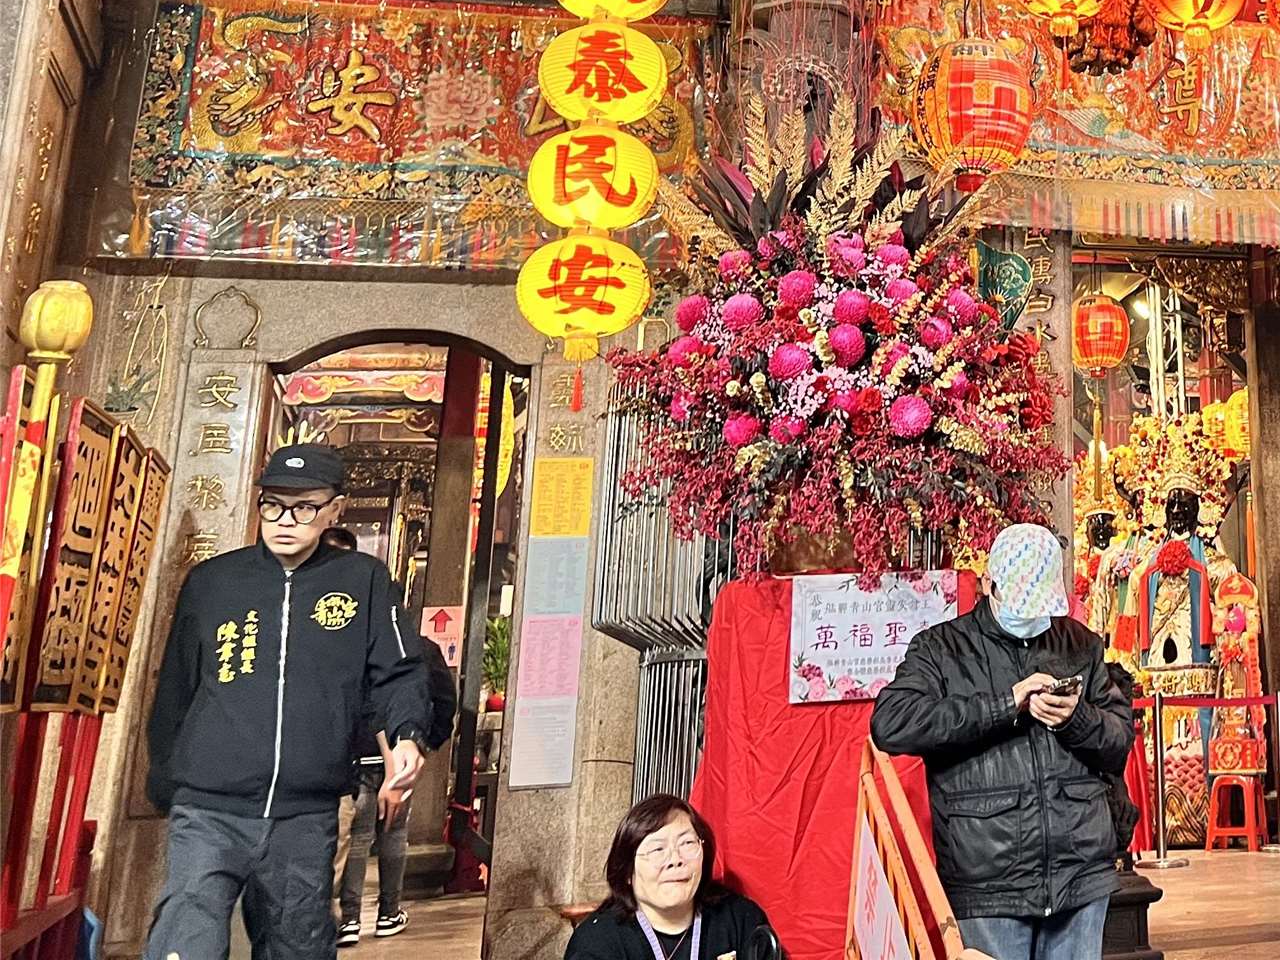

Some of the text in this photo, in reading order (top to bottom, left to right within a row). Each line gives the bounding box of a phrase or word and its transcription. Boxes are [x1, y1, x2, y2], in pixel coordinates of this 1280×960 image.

[308, 51, 397, 141] 安
[566, 31, 648, 102] 泰
[553, 136, 638, 207] 民
[537, 245, 626, 315] 安
[810, 619, 930, 651] 萬福聖
